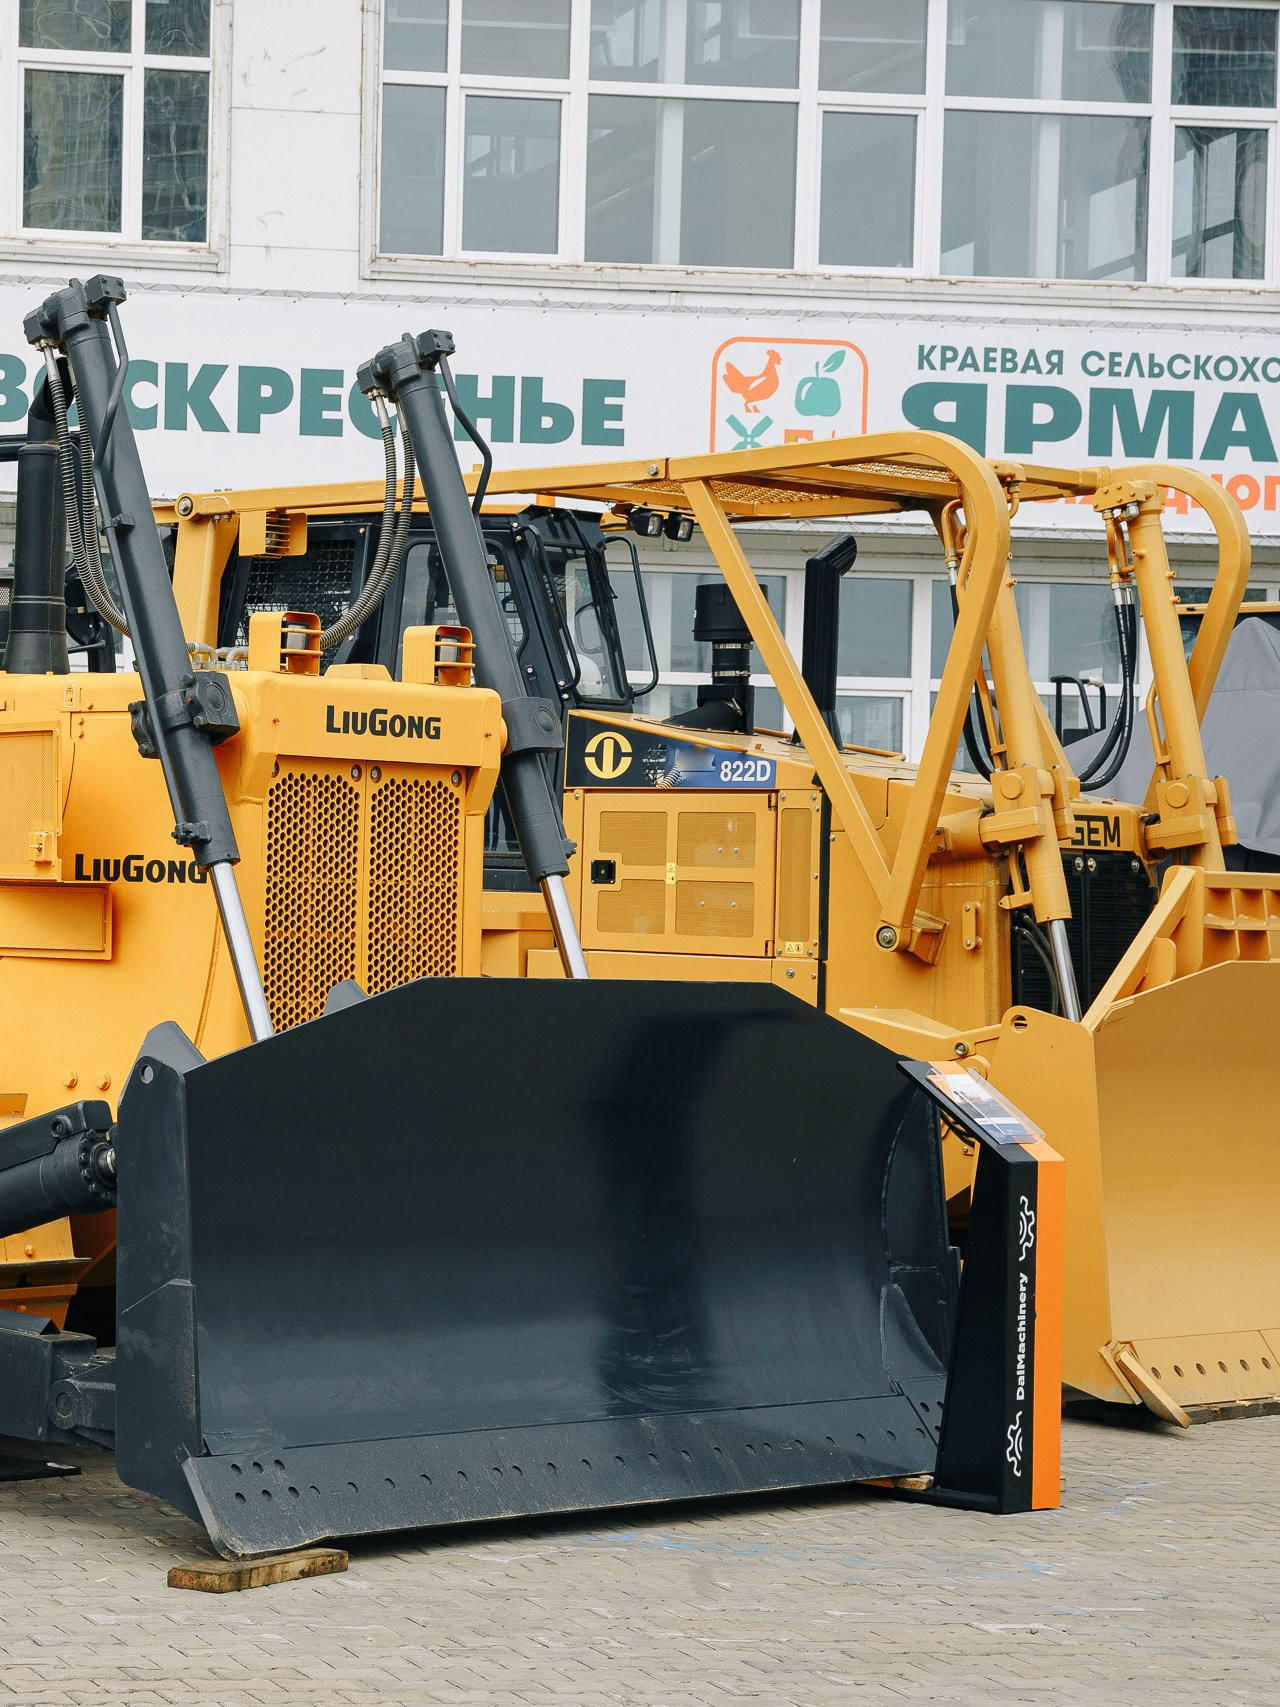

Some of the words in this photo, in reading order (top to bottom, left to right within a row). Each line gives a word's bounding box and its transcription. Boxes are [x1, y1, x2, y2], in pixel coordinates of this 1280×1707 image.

[917, 344, 1064, 375] КРАЕВАЯ
[901, 381, 1279, 462] ЯРМА
[720, 760, 772, 782] 822D
[1016, 1272, 1028, 1400] DalMachinery
